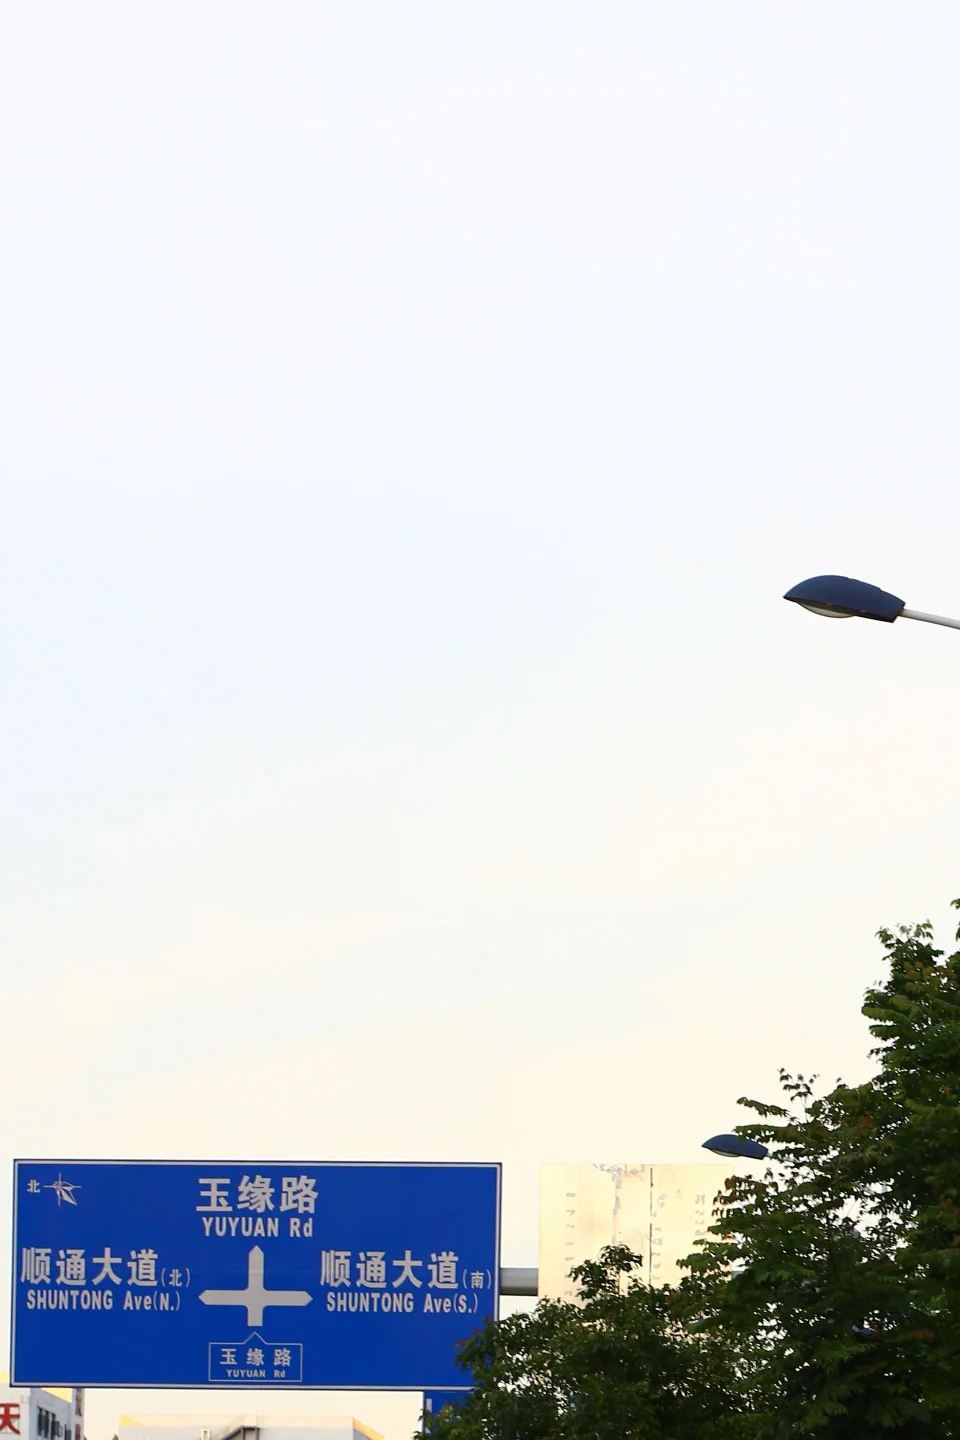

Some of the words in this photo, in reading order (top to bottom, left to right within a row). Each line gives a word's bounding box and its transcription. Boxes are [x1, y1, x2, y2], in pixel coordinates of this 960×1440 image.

[26, 1180, 40, 1194] 北
[196, 1175, 318, 1213] 玉缘路
[202, 1218, 279, 1237] YUYUAN
[290, 1218, 313, 1237] Rd
[26, 1290, 113, 1310] SHUNTONG
[123, 1290, 181, 1311] Ave(N.)
[327, 1291, 414, 1312] SHUNTONG
[423, 1293, 478, 1313] Ave(S.)
[220, 1348, 292, 1367] 玉缘路
[226, 1369, 266, 1378] YUYUAN
[274, 1369, 286, 1378] Rd
